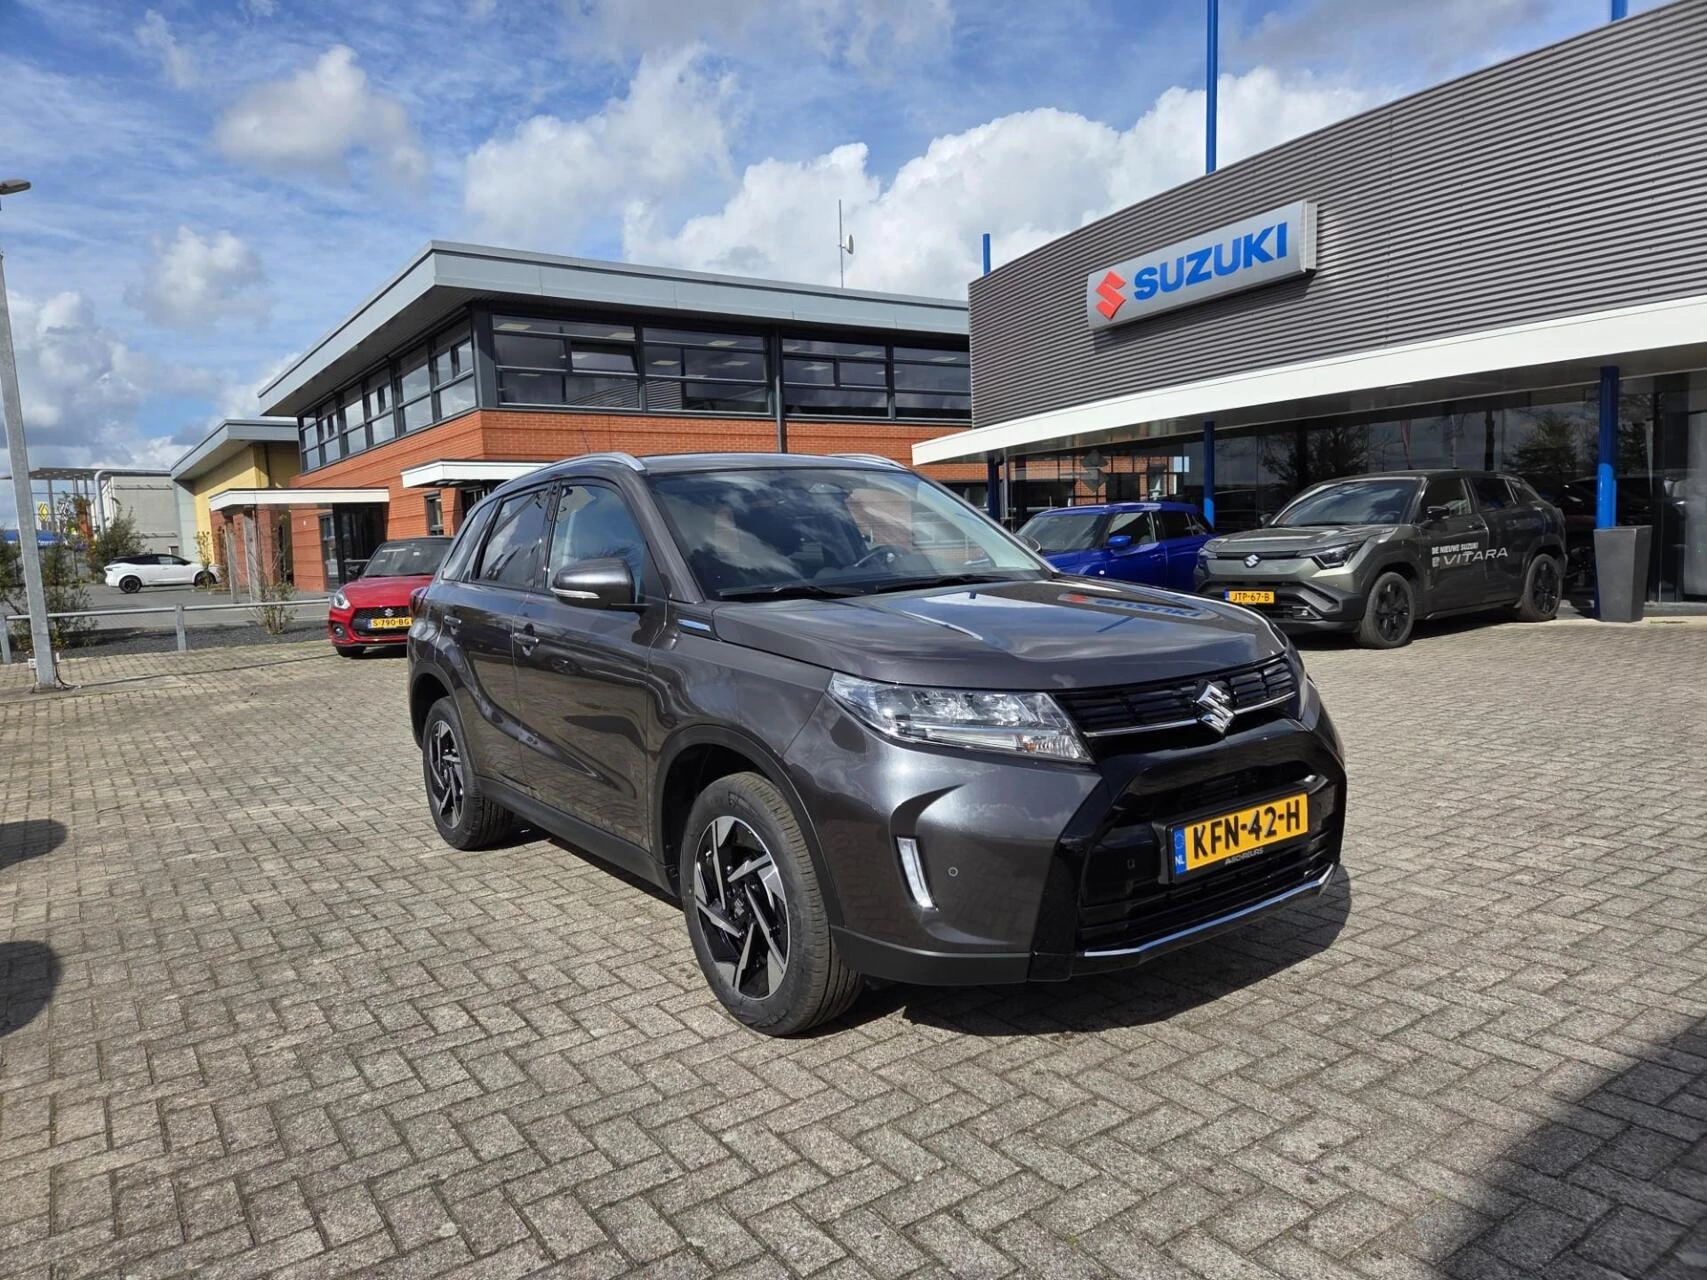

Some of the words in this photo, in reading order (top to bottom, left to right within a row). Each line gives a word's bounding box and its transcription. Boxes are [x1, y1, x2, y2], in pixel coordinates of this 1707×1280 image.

[1134, 221, 1288, 301] SUZUKI
[1431, 546, 1439, 555] DE
[1440, 544, 1460, 553] NIEUWE
[1460, 542, 1479, 551] SUZUKI
[1443, 546, 1509, 565] VITARA
[1232, 592, 1270, 602] JTP-67-B
[1193, 799, 1300, 859] KFN-42-H
[1175, 855, 1185, 865] NL
